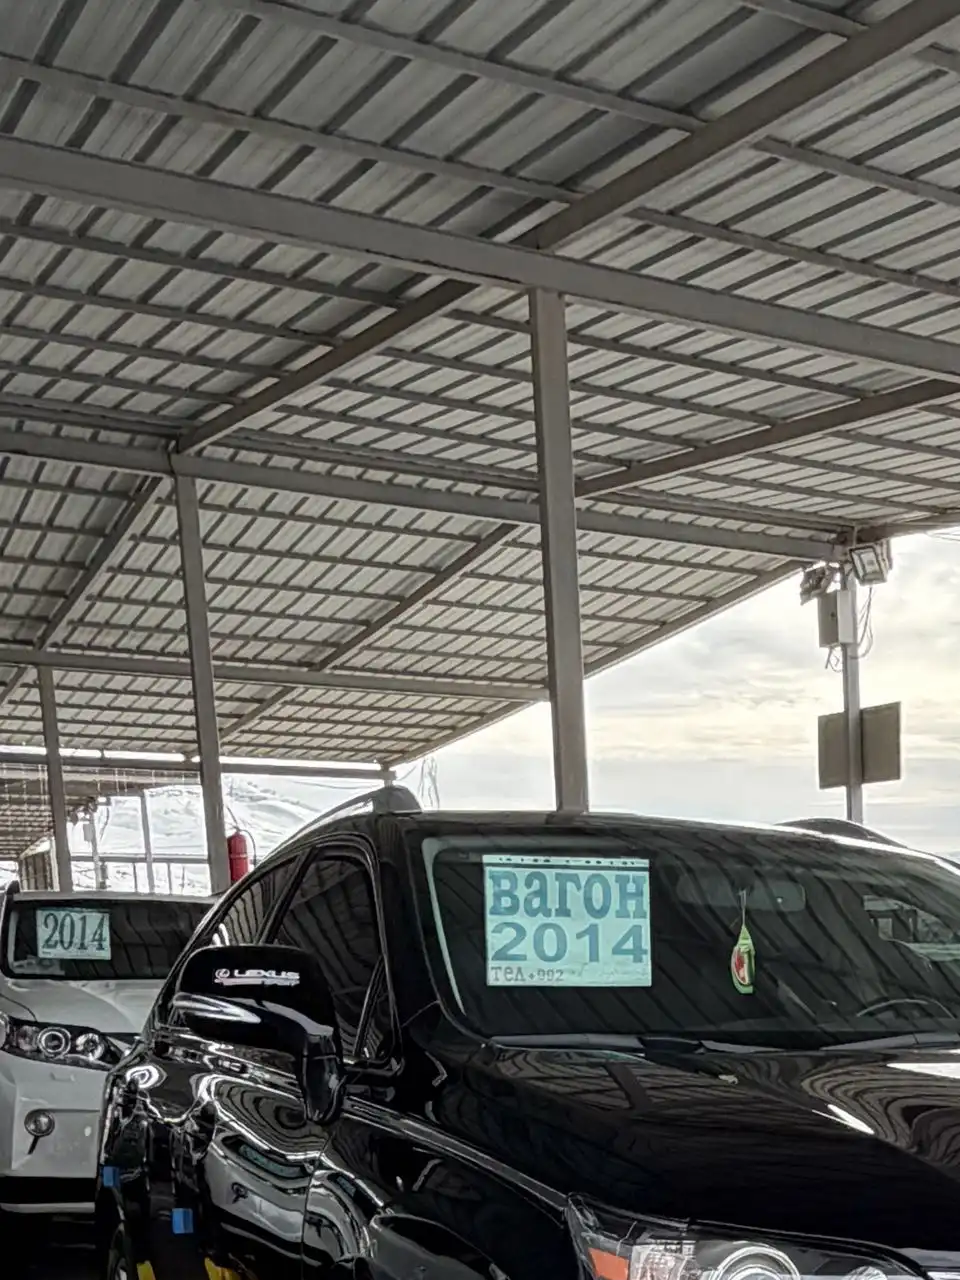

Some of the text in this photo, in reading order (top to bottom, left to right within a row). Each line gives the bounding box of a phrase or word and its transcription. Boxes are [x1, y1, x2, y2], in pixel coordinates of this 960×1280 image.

[42, 912, 107, 951] 2014
[491, 921, 648, 963] 2014
[234, 969, 300, 979] LEXUS
